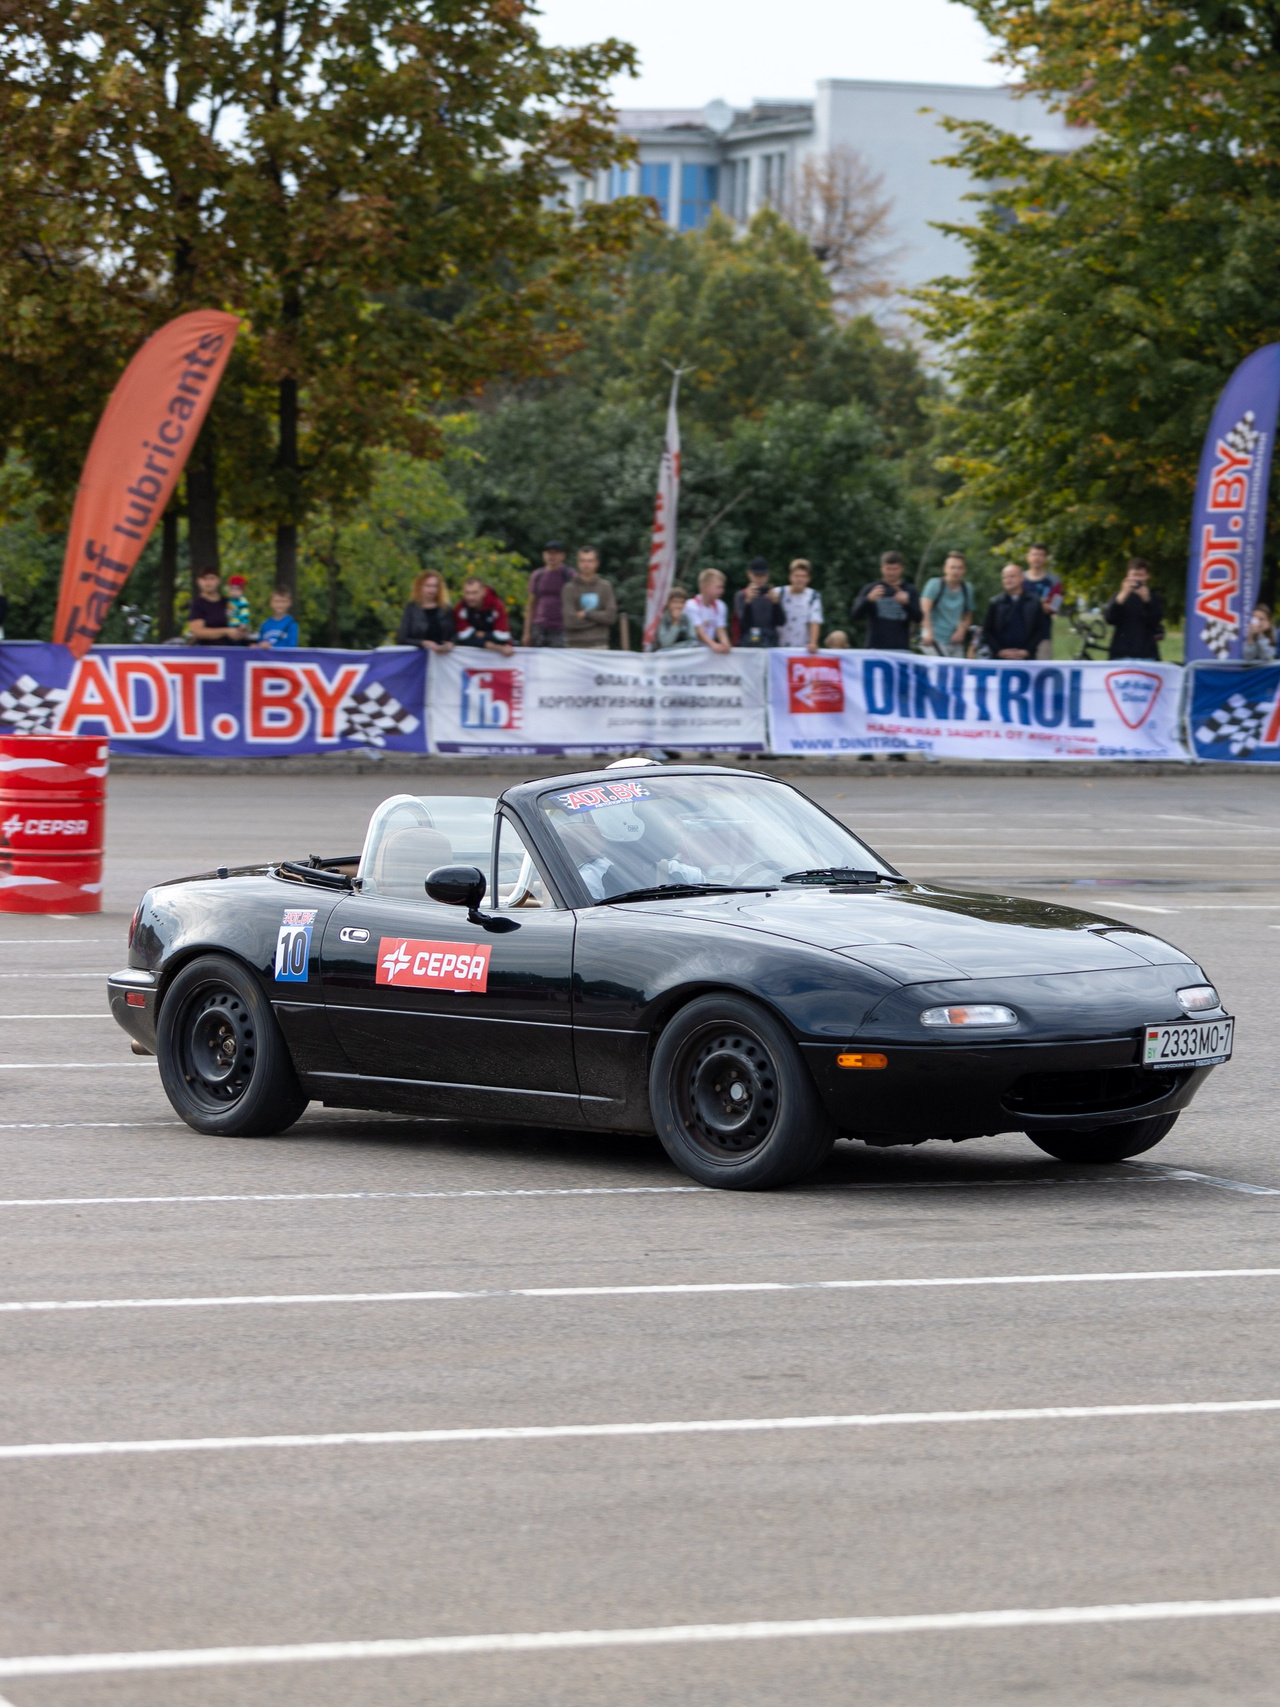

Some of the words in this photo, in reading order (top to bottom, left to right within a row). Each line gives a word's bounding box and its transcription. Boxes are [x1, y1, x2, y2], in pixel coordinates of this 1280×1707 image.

[64, 539, 131, 644] Taif
[114, 333, 225, 541] lubricants
[1195, 439, 1254, 625] ADT.BY
[54, 655, 370, 743] ADT.BY
[863, 659, 1095, 728] DINITROL
[567, 783, 642, 810] ADT.BY
[24, 819, 90, 836] CEPSA
[280, 930, 309, 976] 10
[412, 951, 487, 981] CEPSA
[1147, 1047, 1157, 1059] BY
